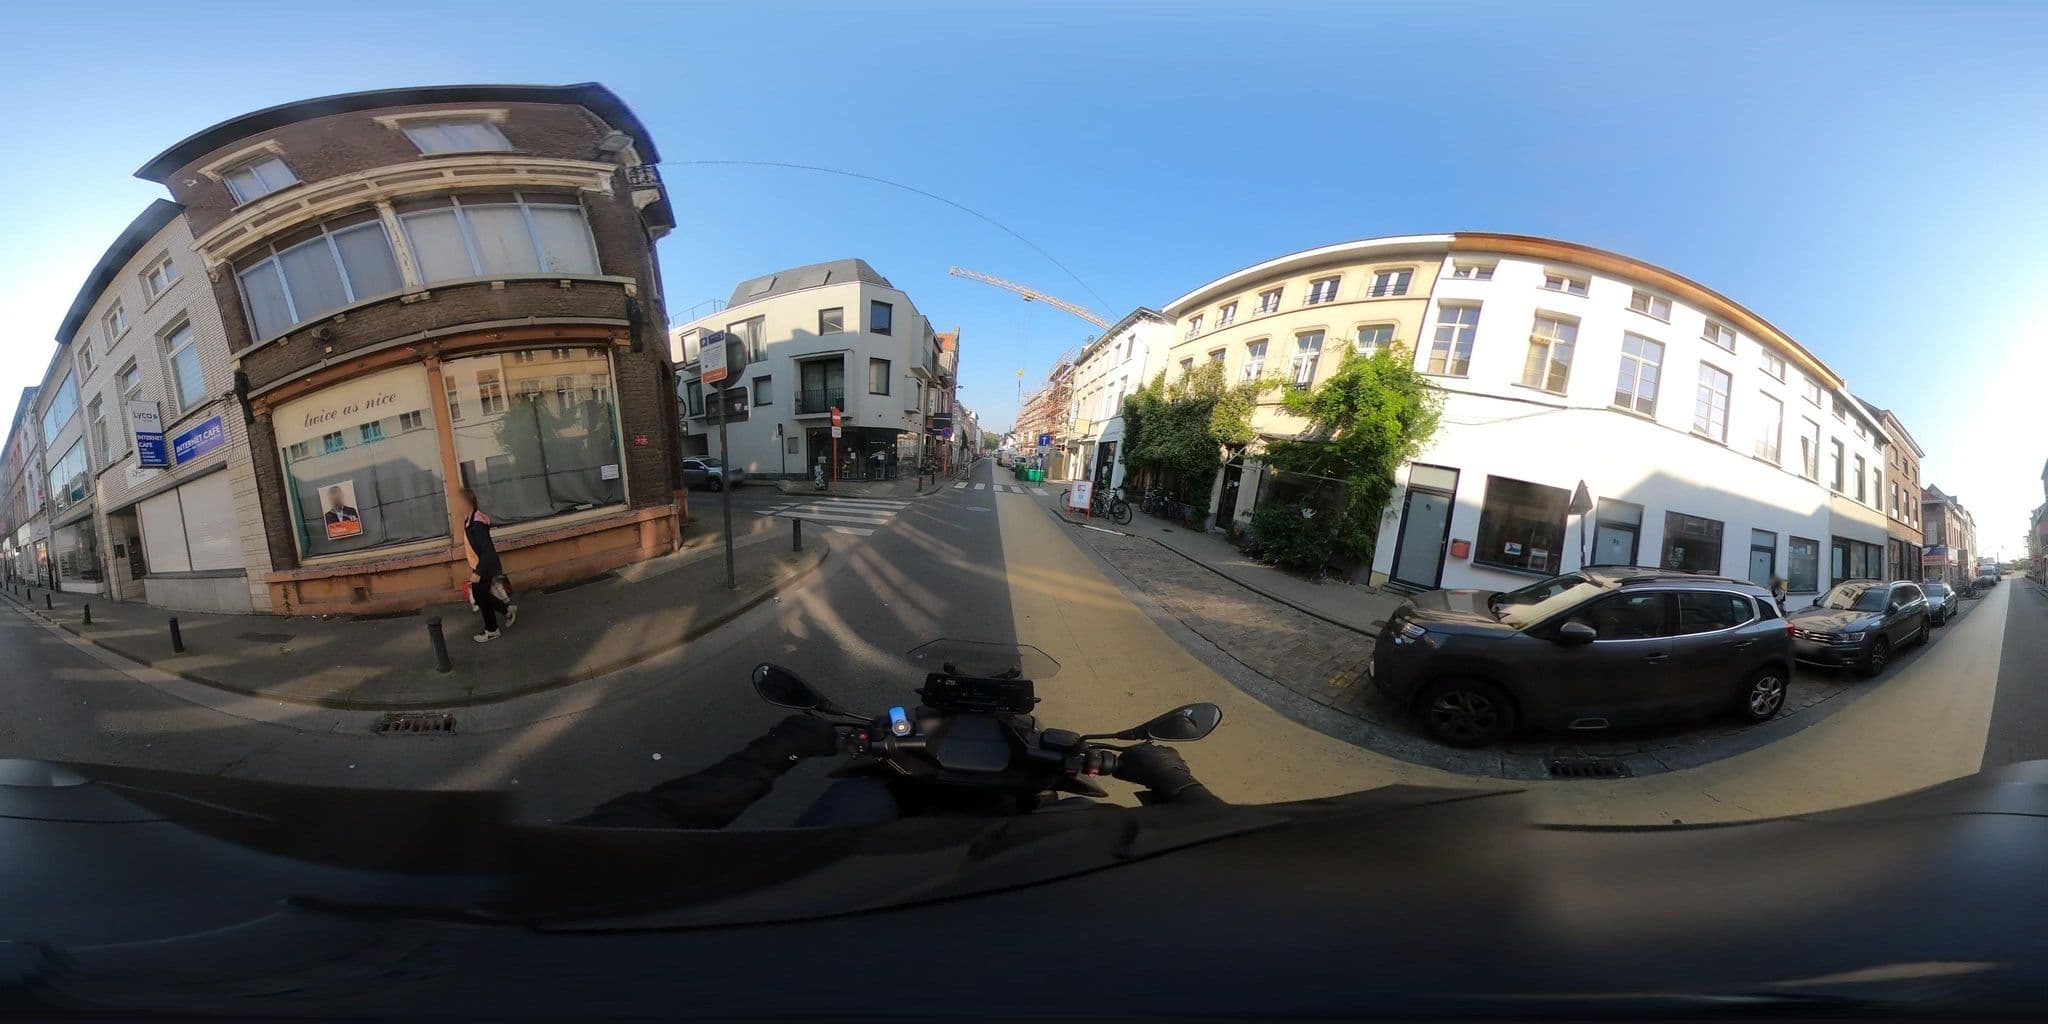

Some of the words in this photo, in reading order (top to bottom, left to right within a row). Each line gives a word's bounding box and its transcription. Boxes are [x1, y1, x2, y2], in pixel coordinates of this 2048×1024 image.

[304, 408, 337, 428] twice
[343, 402, 359, 415] as
[366, 392, 397, 409] nice
[138, 434, 163, 442] INTERNET
[176, 433, 203, 453] INTERNET
